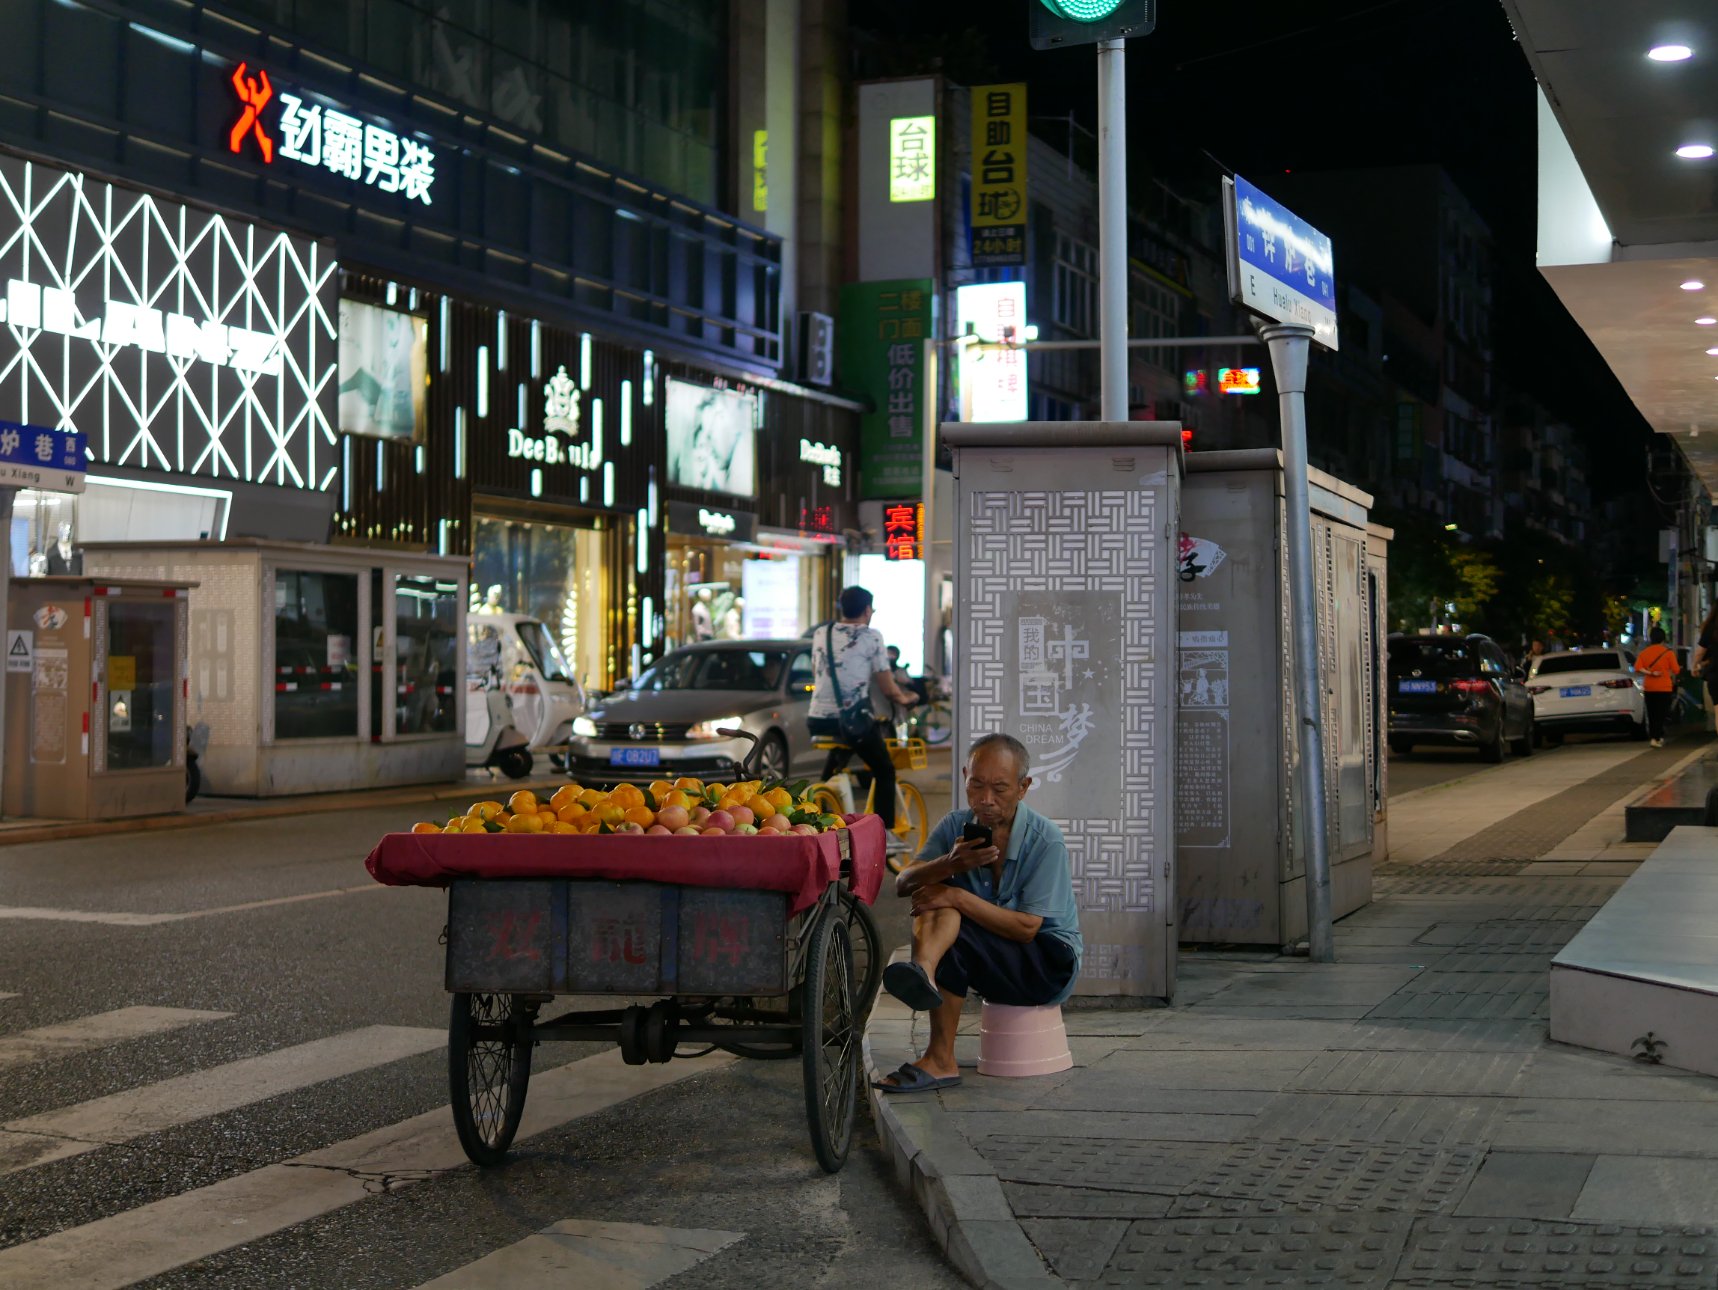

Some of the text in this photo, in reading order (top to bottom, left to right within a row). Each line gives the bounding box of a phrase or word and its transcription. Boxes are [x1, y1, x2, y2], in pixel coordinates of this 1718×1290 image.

[279, 93, 435, 205] 劲霸男装
[894, 122, 930, 182] 台球
[1249, 274, 1256, 297] E
[879, 290, 922, 311] 二楼
[0, 278, 284, 377] ILANZ
[878, 318, 922, 340] 门面
[887, 344, 915, 438] 低价出售
[11, 468, 40, 482] Xiang
[65, 475, 75, 487] W
[885, 506, 916, 560] 宾馆
[1023, 627, 1040, 662] 我的
[1019, 723, 1053, 733] CHINA
[1025, 734, 1064, 744] DREAM
